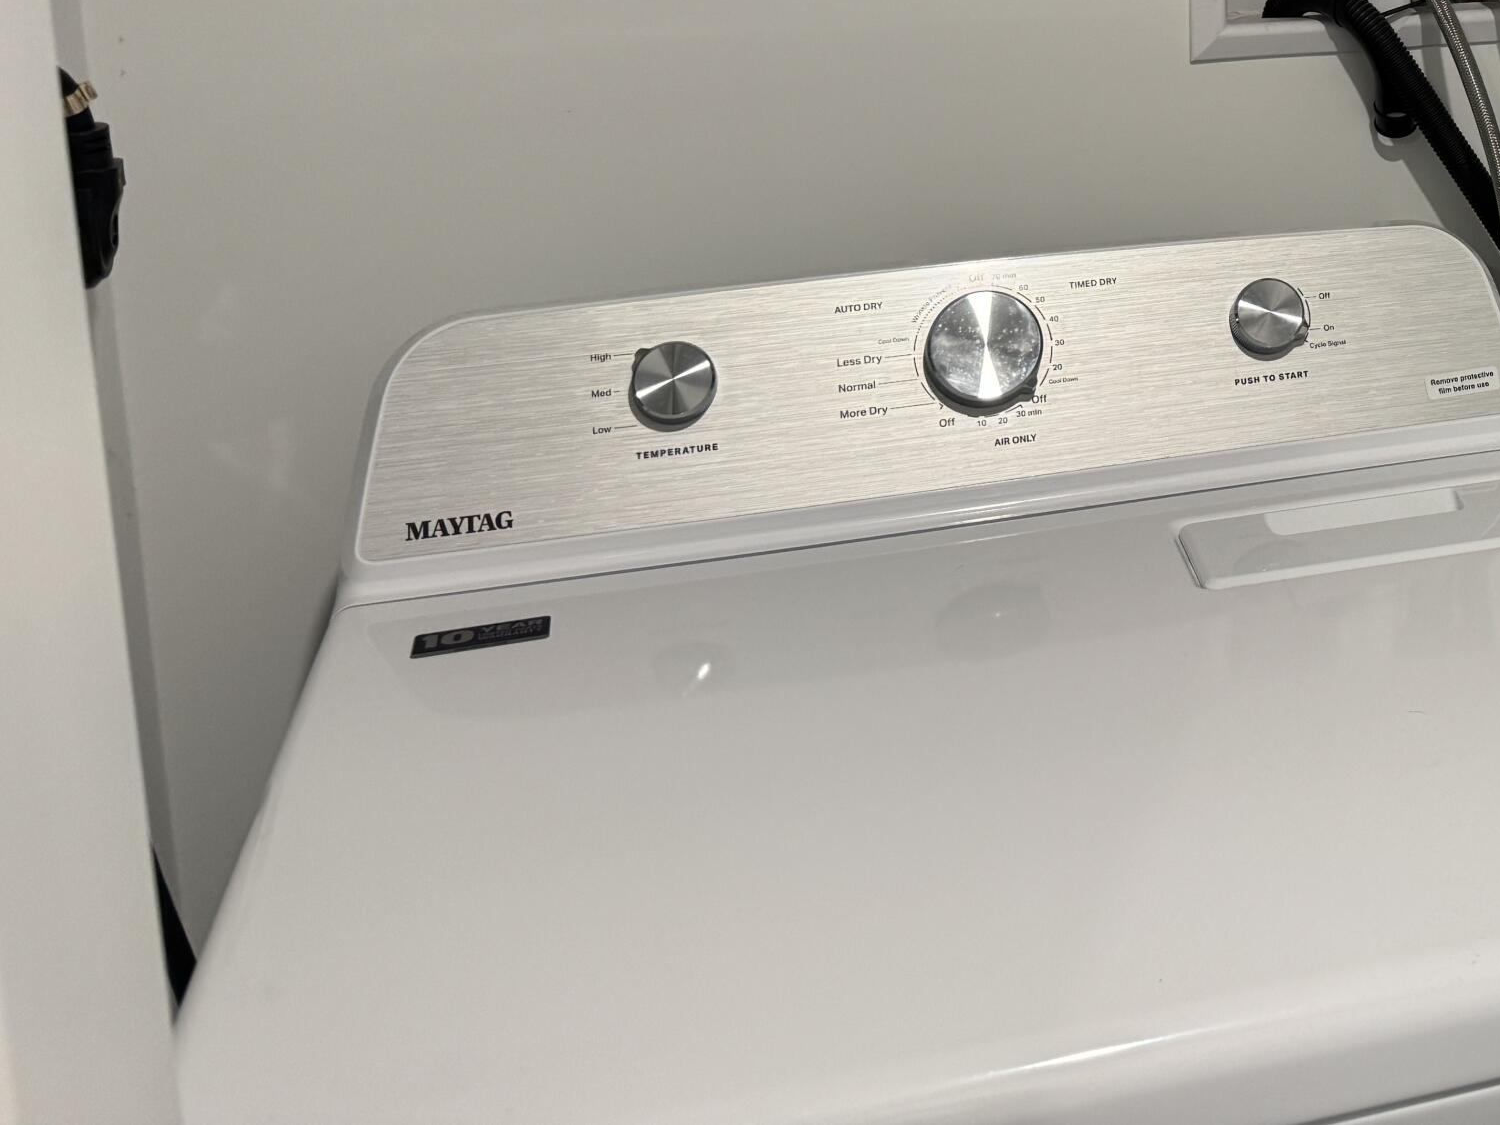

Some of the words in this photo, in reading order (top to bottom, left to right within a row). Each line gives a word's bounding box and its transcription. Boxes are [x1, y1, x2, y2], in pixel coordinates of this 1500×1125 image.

[1069, 278, 1098, 289] TIMED
[1099, 277, 1118, 287] DRY
[834, 303, 861, 314] AUTO
[863, 301, 883, 313] DRY
[1323, 324, 1335, 332] On
[589, 353, 612, 363] High
[836, 356, 862, 368] Less
[863, 354, 883, 367] Dry
[1052, 363, 1063, 371] 20
[1234, 375, 1260, 386] PUSH
[1263, 374, 1276, 383] TO
[1279, 370, 1309, 381] START
[1430, 376, 1459, 386] Remove
[1460, 371, 1494, 383] protective
[591, 388, 612, 398] Med
[837, 381, 877, 394] Normal
[1438, 387, 1452, 395] film
[1453, 383, 1476, 393] before
[1031, 394, 1048, 404] Off
[839, 407, 867, 420] More
[869, 405, 889, 418] Dry
[1016, 410, 1026, 418] 30
[1027, 408, 1043, 417] min
[938, 417, 956, 428] Off
[977, 419, 987, 427] 10
[998, 417, 1009, 425] 20
[592, 426, 612, 435] Low
[994, 437, 1011, 447] AIR
[1012, 433, 1037, 445] ONLY
[636, 443, 719, 460] TEMPERATURE
[405, 511, 514, 542] MAYTAG
[422, 629, 475, 650] 10
